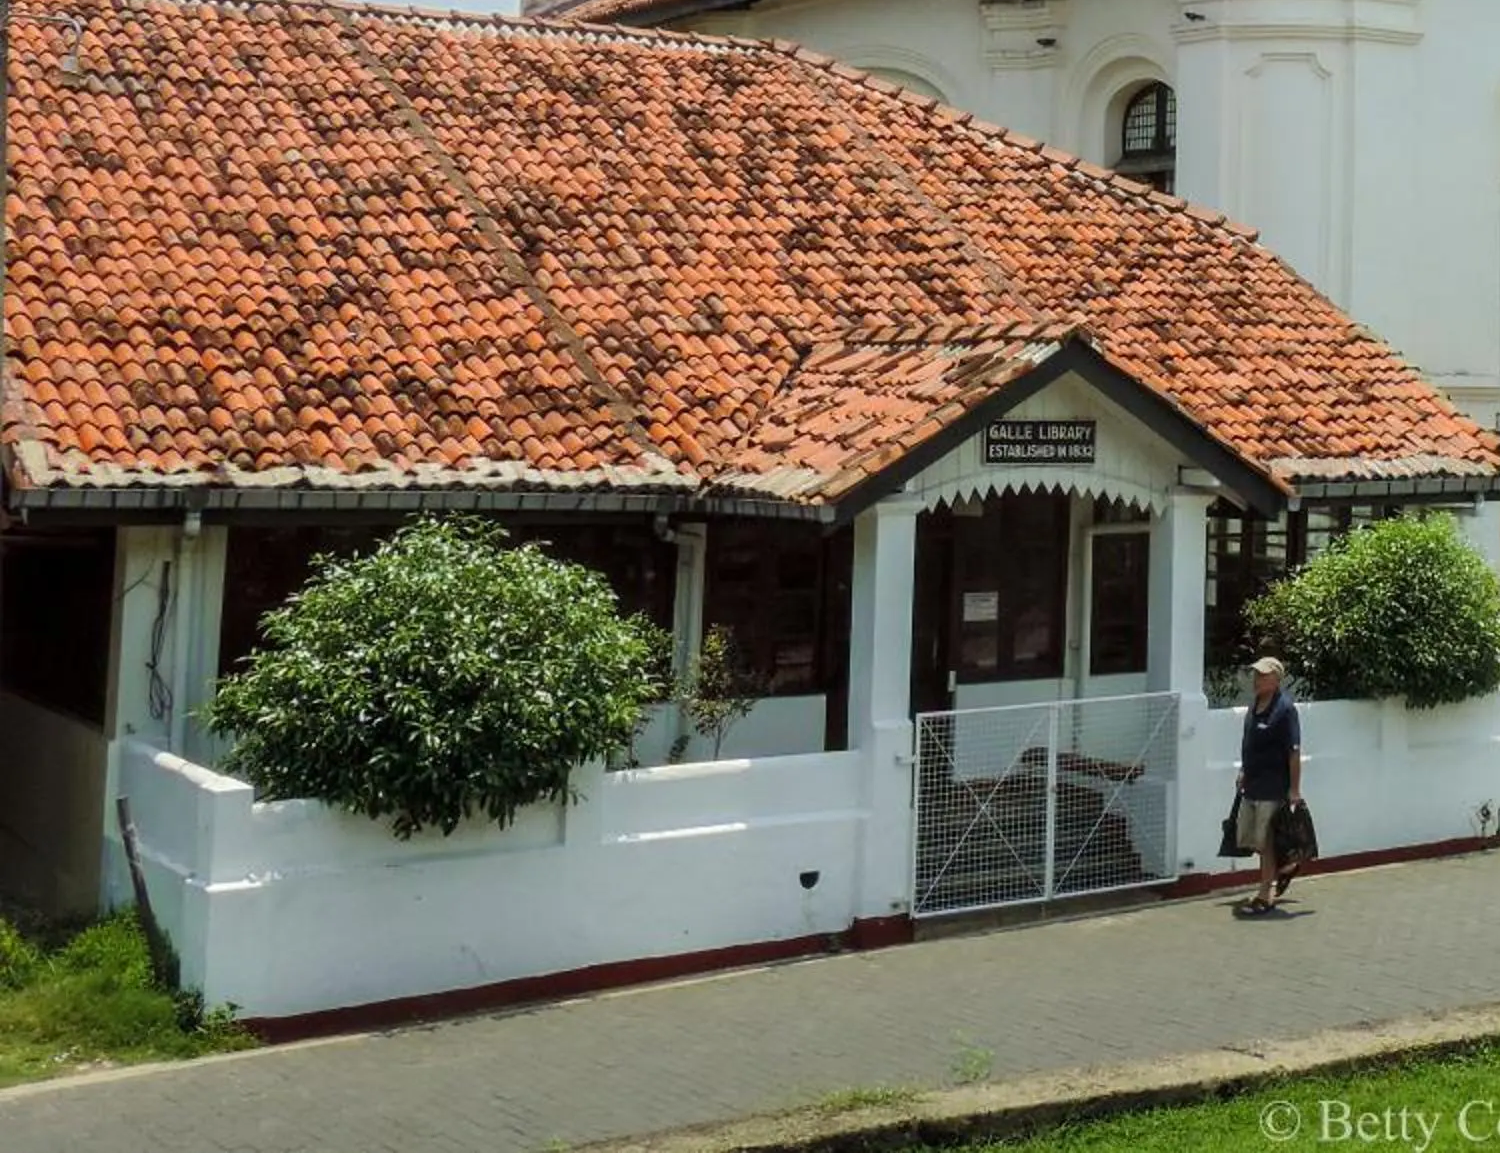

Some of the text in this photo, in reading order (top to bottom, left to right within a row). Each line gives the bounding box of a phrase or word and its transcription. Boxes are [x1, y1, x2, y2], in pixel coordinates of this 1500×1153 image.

[989, 424, 1091, 440] GALLE LIBRARY
[989, 444, 1056, 458] ESTABLISHED
[1058, 444, 1067, 458] IN
